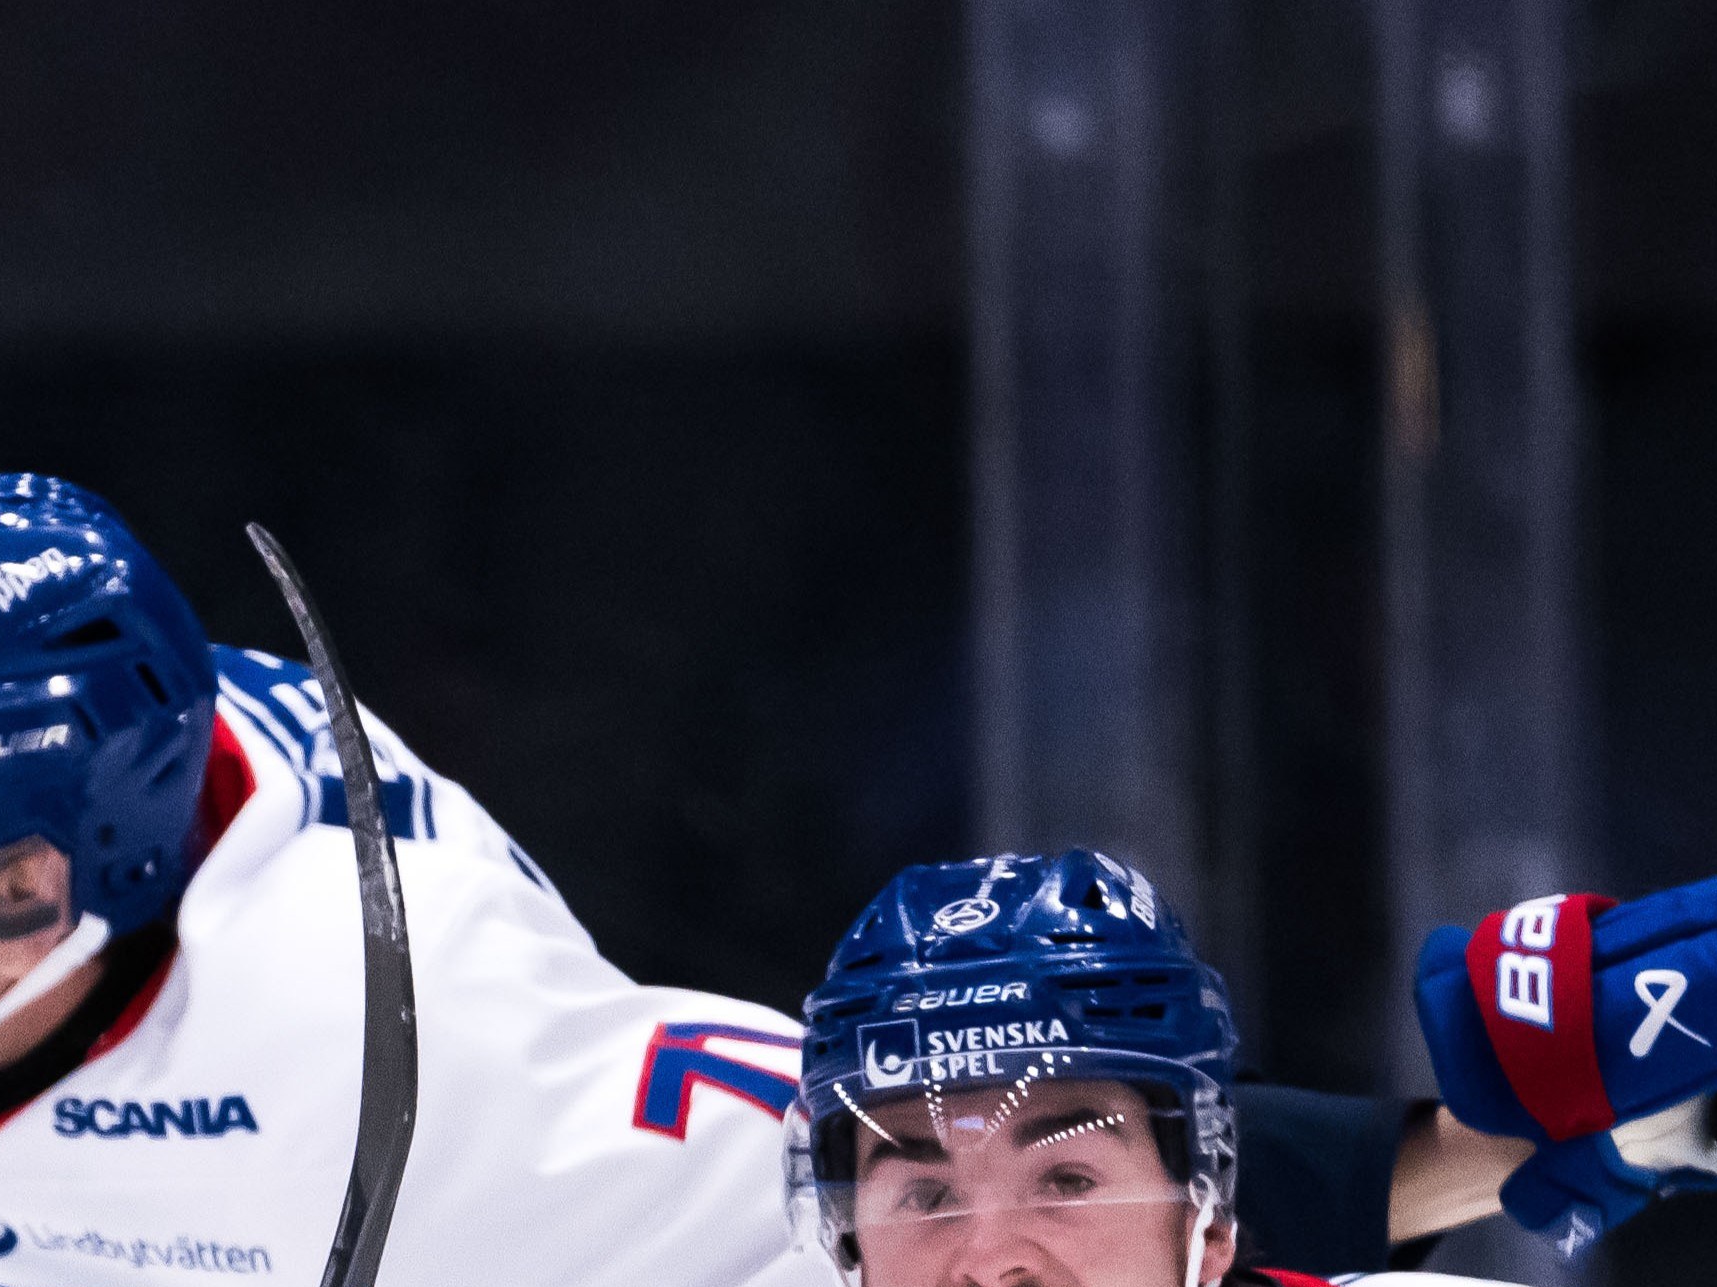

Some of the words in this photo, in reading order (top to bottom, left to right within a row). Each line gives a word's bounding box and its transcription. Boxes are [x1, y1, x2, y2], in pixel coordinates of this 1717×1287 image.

[892, 981, 1031, 1013] BAUER
[927, 1019, 1069, 1054] SVENSKA
[929, 1052, 1005, 1081] SPEL
[54, 1096, 259, 1139] SCANIA
